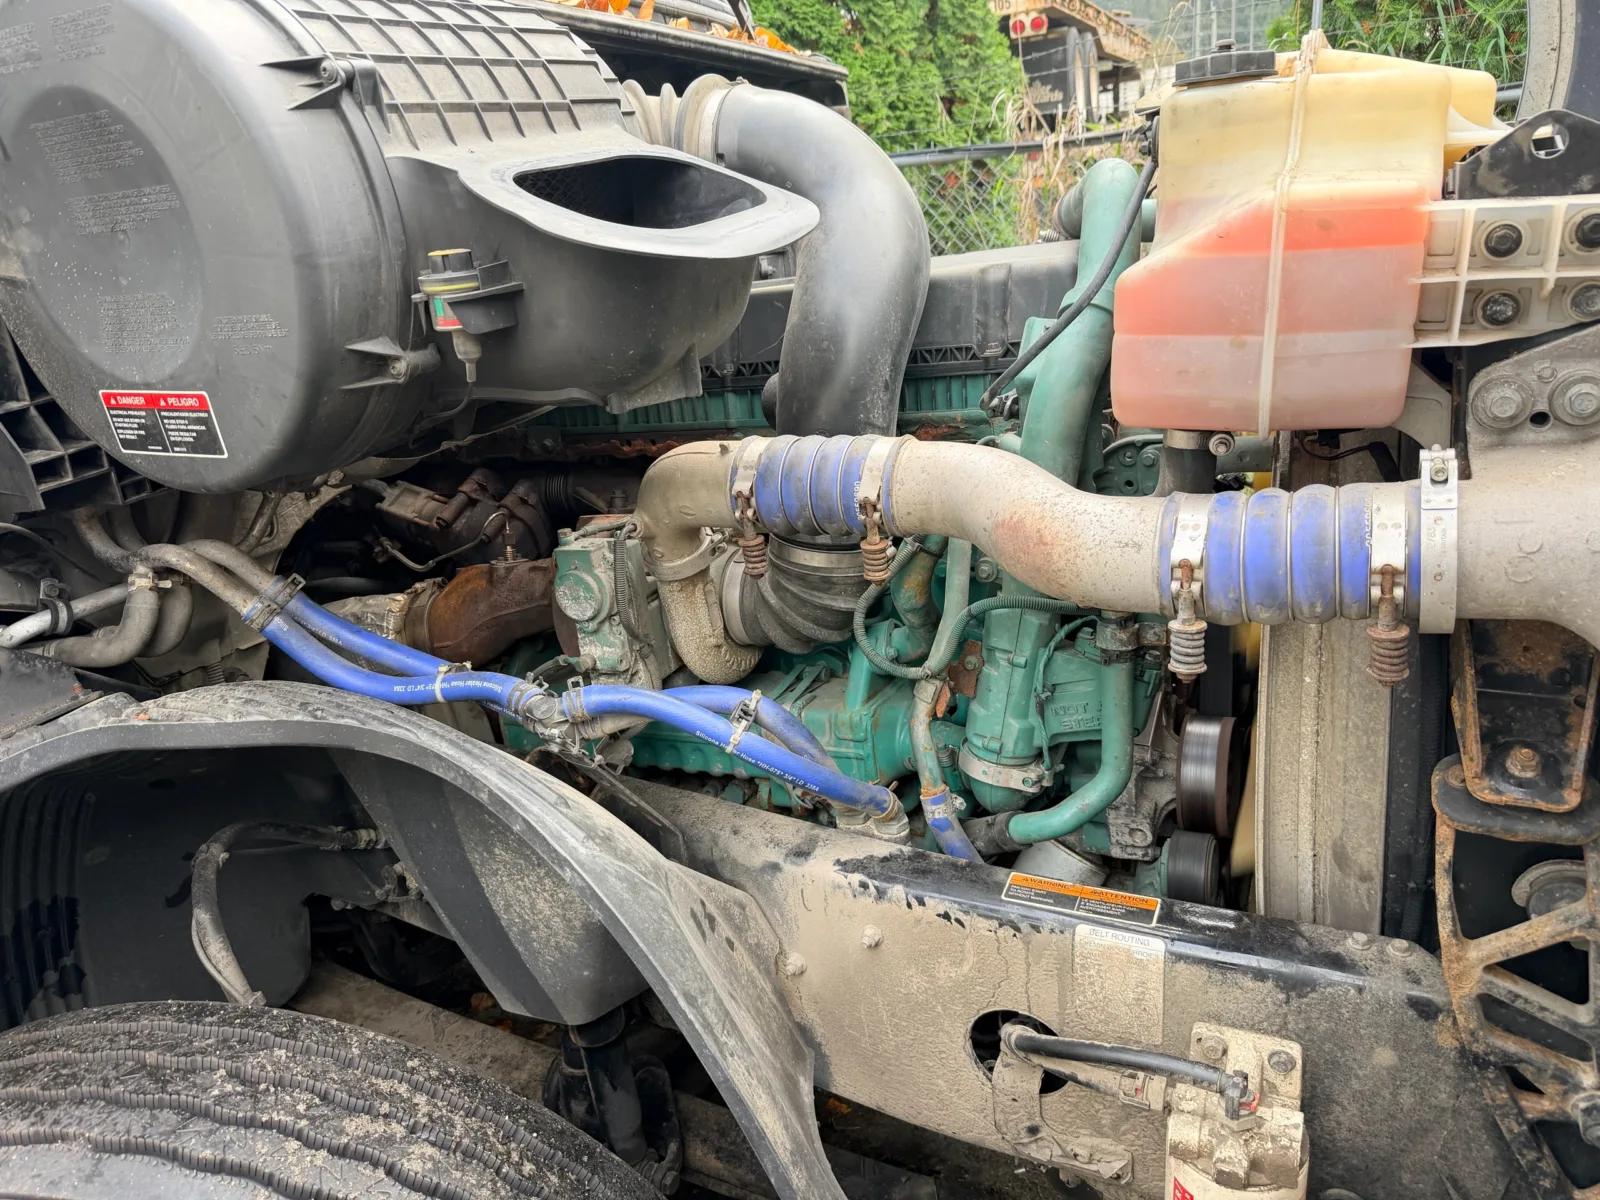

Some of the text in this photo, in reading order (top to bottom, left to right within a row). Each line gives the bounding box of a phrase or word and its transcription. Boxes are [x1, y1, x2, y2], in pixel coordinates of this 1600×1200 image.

[117, 396, 146, 406] DANGER
[167, 397, 199, 407] PELIGRO
[1050, 702, 1088, 717] NOT
[695, 730, 720, 746] Silicone
[740, 751, 756, 764] Hose
[1029, 877, 1072, 890] WARNING
[1098, 890, 1149, 904] ATTENTION
[1089, 928, 1150, 947] BELT ROUTING
